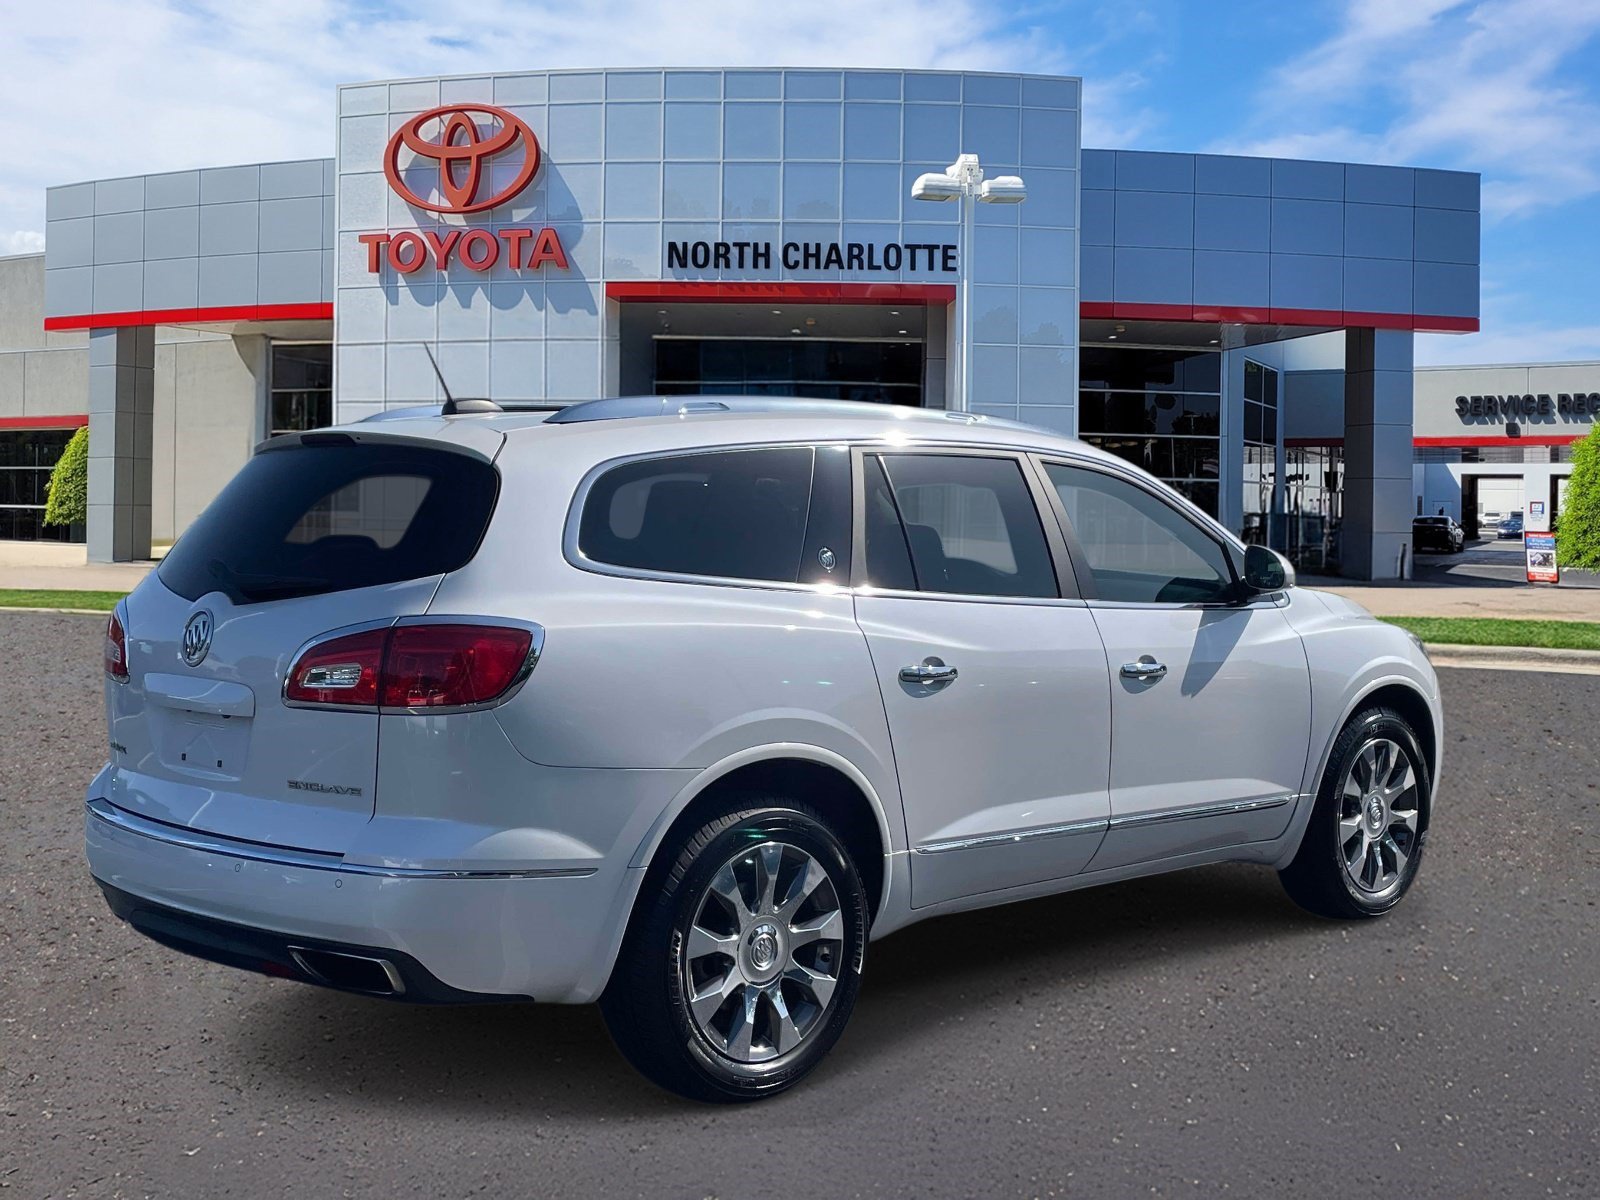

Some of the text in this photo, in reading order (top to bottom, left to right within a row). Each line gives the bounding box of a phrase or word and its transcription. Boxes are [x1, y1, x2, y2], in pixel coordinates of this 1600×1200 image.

[359, 228, 569, 273] TOYOTA
[667, 241, 958, 271] NORTH CHARLOTTE
[1455, 392, 1600, 416] SERVICE REC
[287, 780, 362, 797] ENCLAVE
